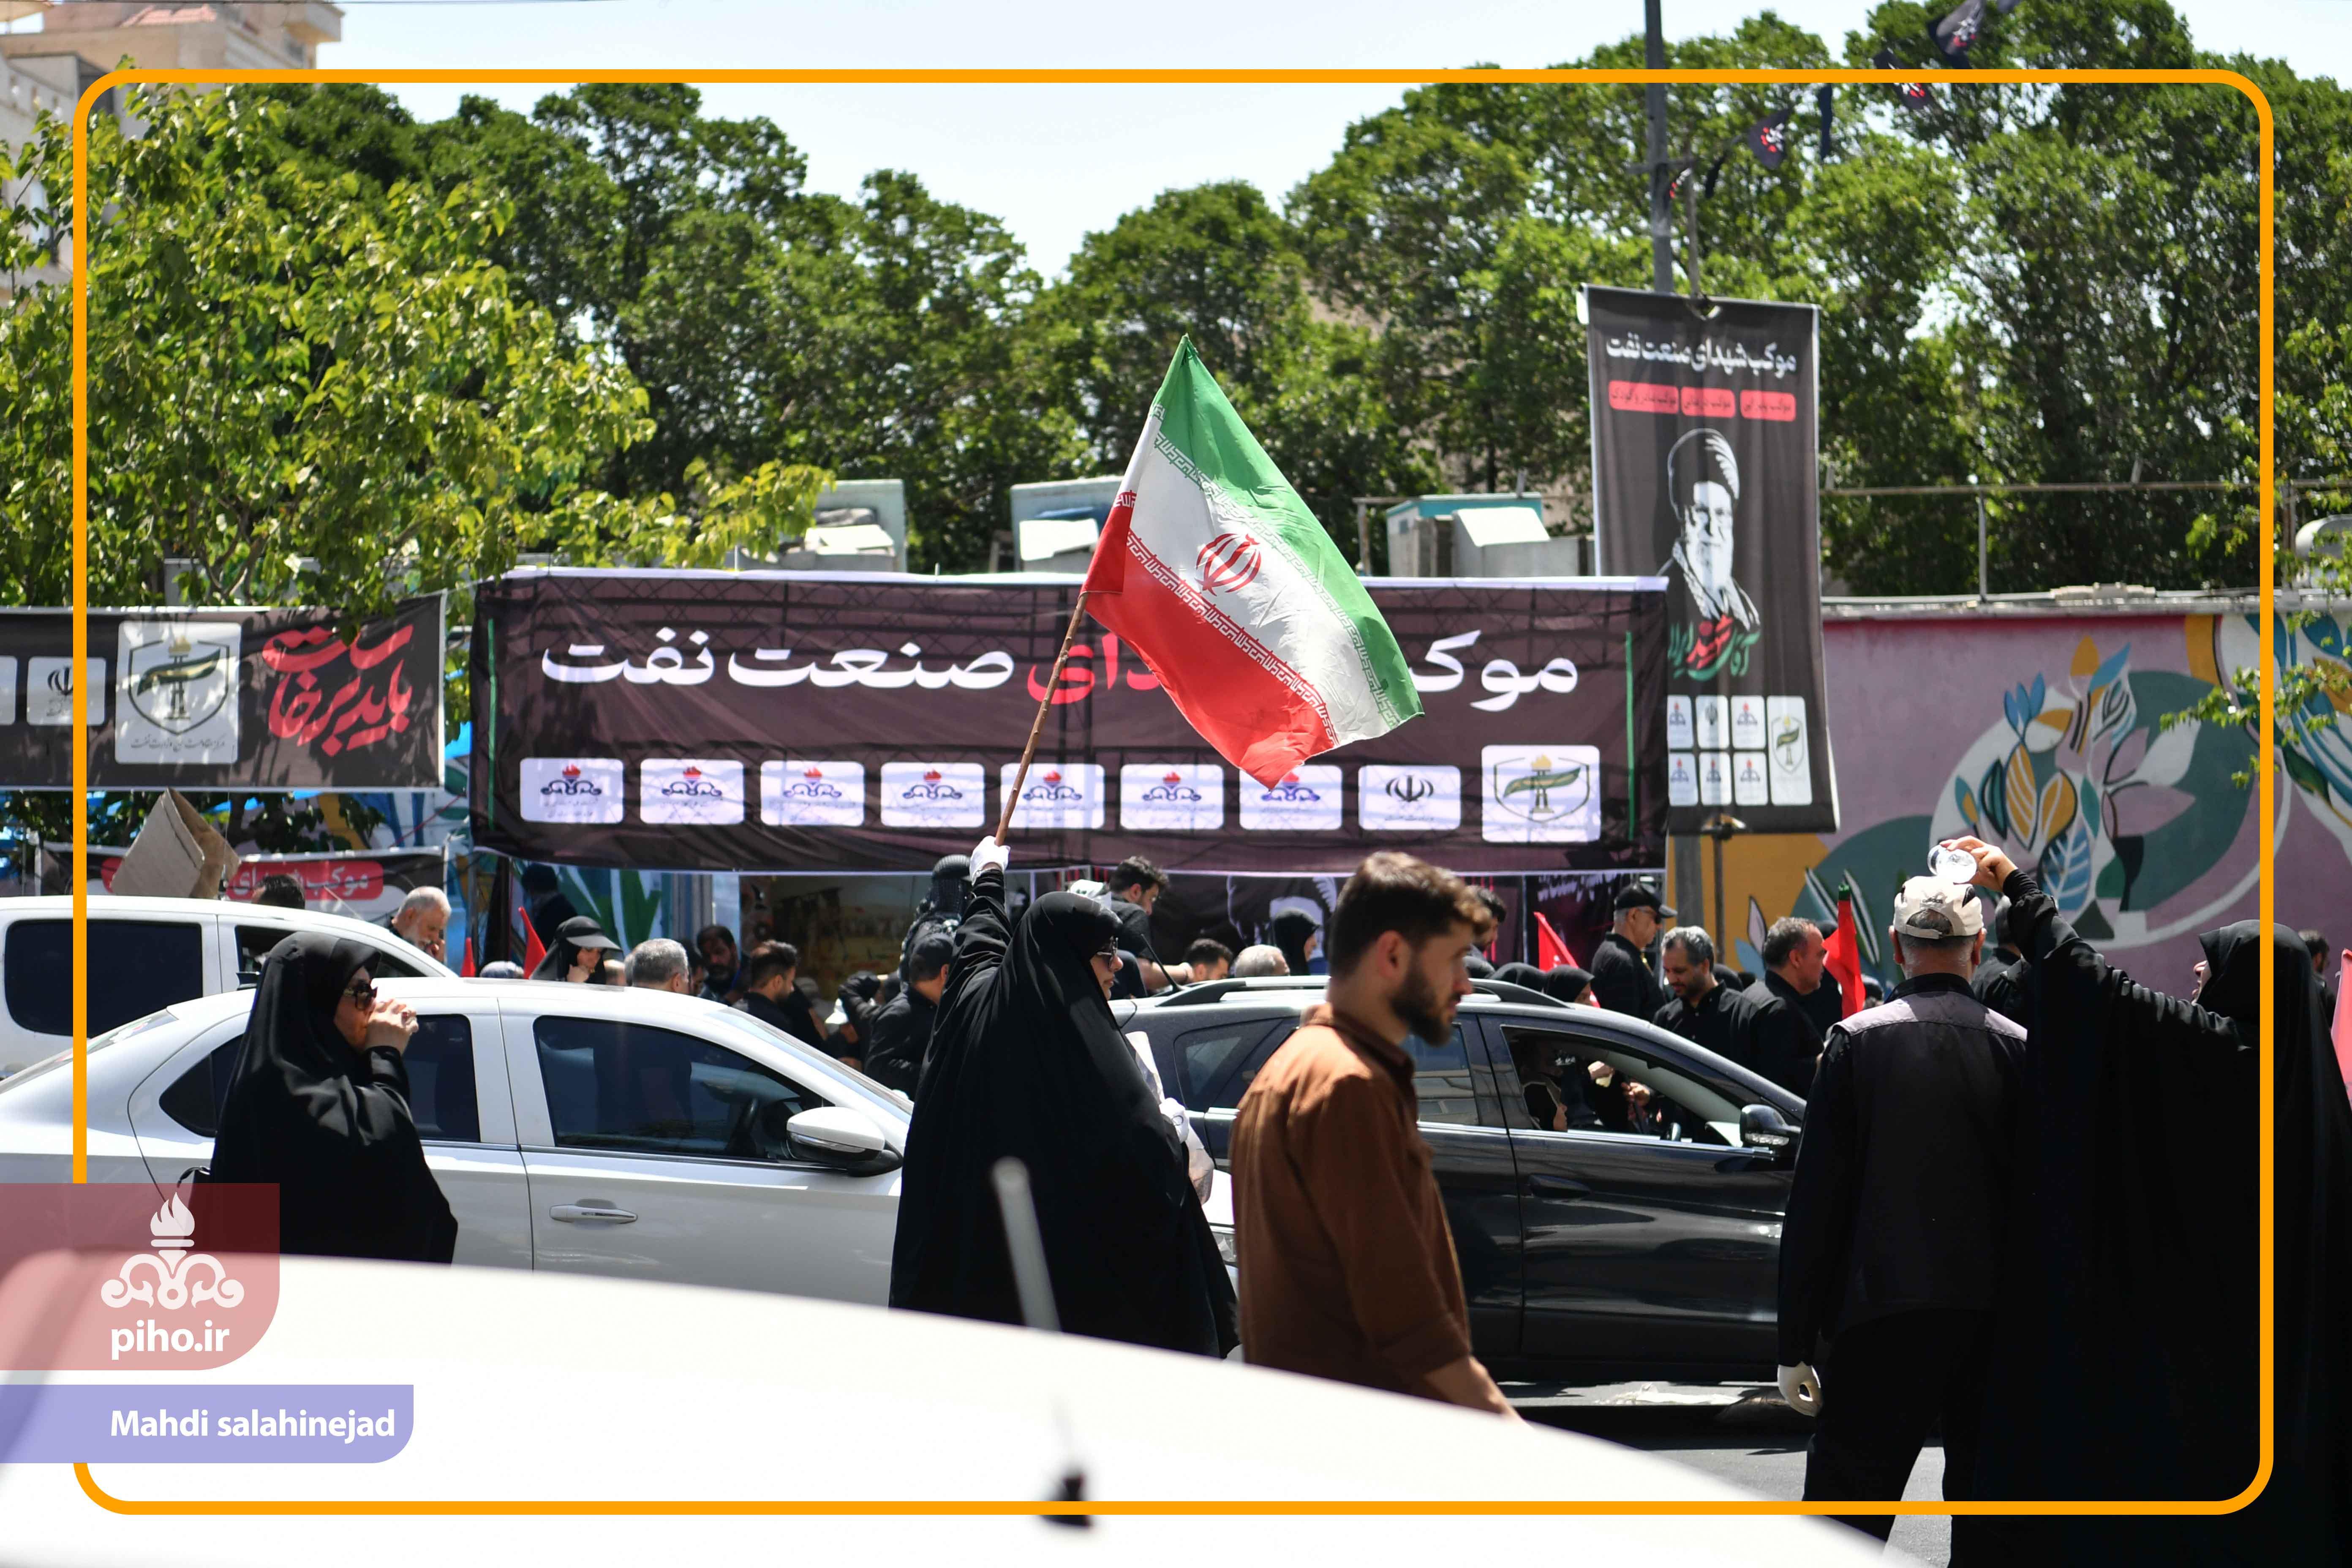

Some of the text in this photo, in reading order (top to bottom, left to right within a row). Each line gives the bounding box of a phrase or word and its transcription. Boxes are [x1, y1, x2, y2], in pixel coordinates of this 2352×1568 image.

[1606, 332, 1796, 378] موکب شهدای صنعت نفت
[542, 627, 714, 685] نفت
[728, 642, 1014, 689] صنعت
[1027, 632, 1161, 705] دای
[1408, 630, 1578, 712] موک
[306, 866, 368, 896] موکب
